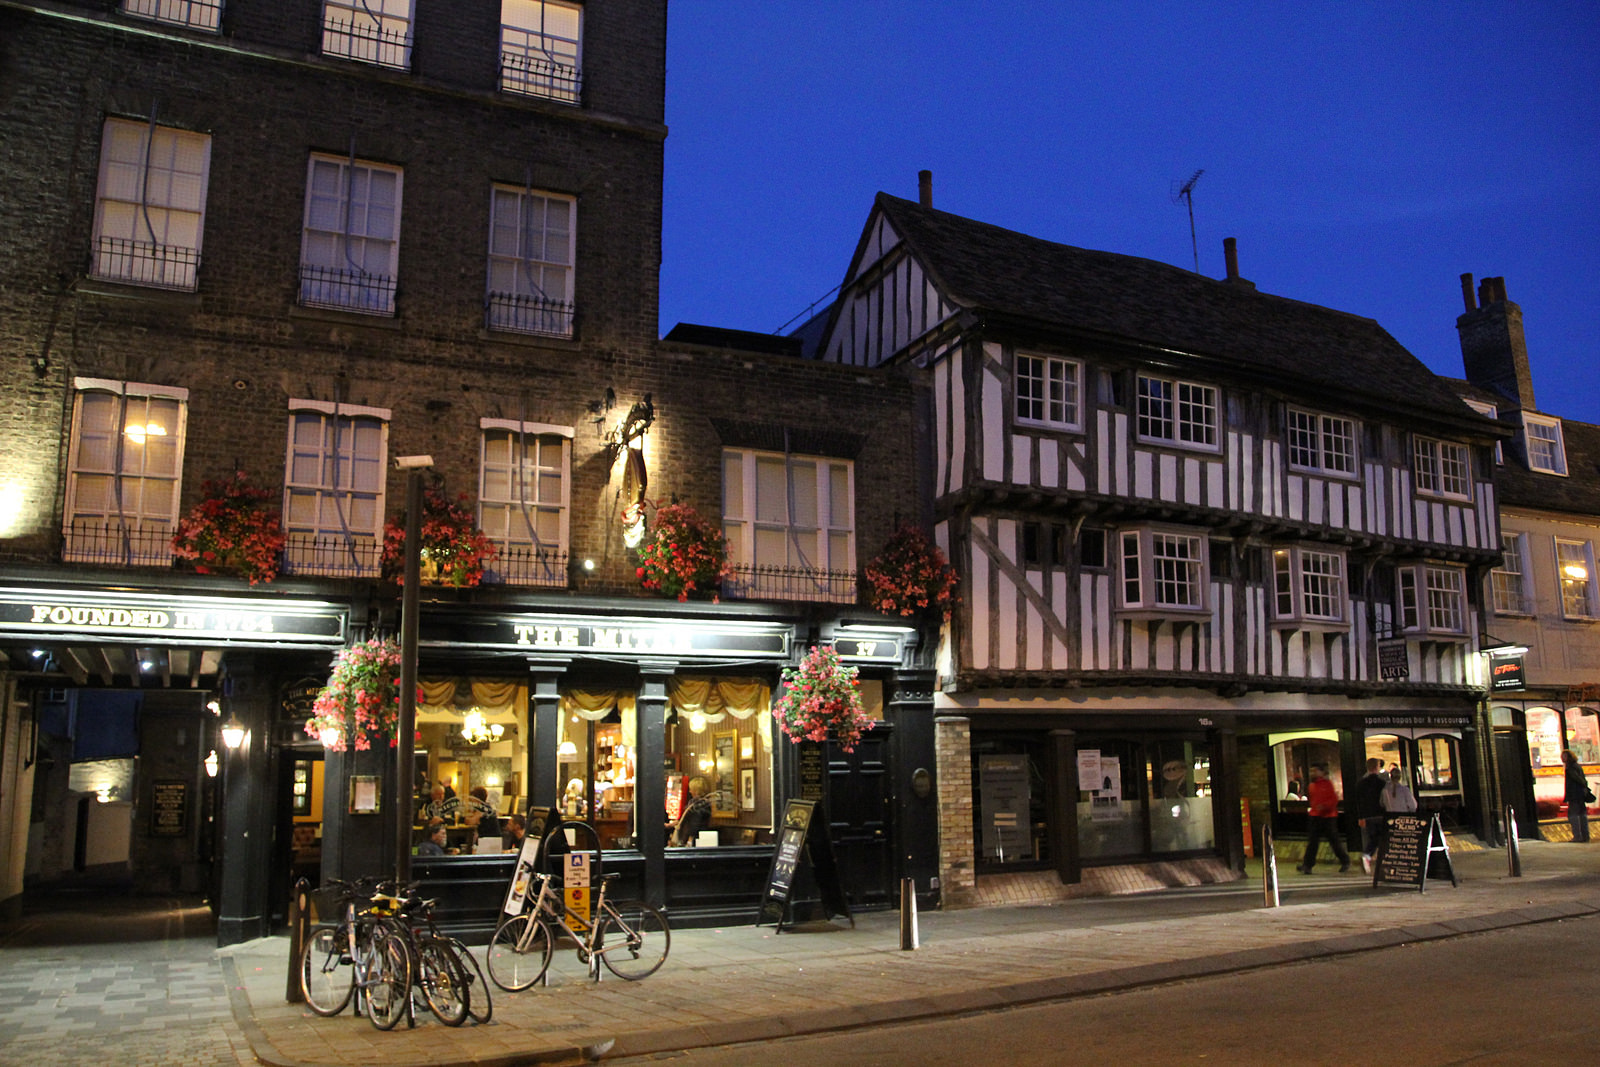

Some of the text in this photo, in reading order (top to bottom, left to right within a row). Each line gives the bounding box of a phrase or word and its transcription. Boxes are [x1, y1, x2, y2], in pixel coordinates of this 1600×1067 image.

[31, 606, 273, 632] FOUNDED IN 1754
[514, 625, 691, 650] THE MITRE
[856, 642, 877, 656] 17
[1383, 666, 1408, 678] ARTS
[1364, 716, 1391, 725] spanish
[1392, 716, 1412, 725] tapas
[1413, 716, 1425, 724] bar
[1433, 716, 1470, 724] restaurant
[1394, 818, 1420, 826] CURRY
